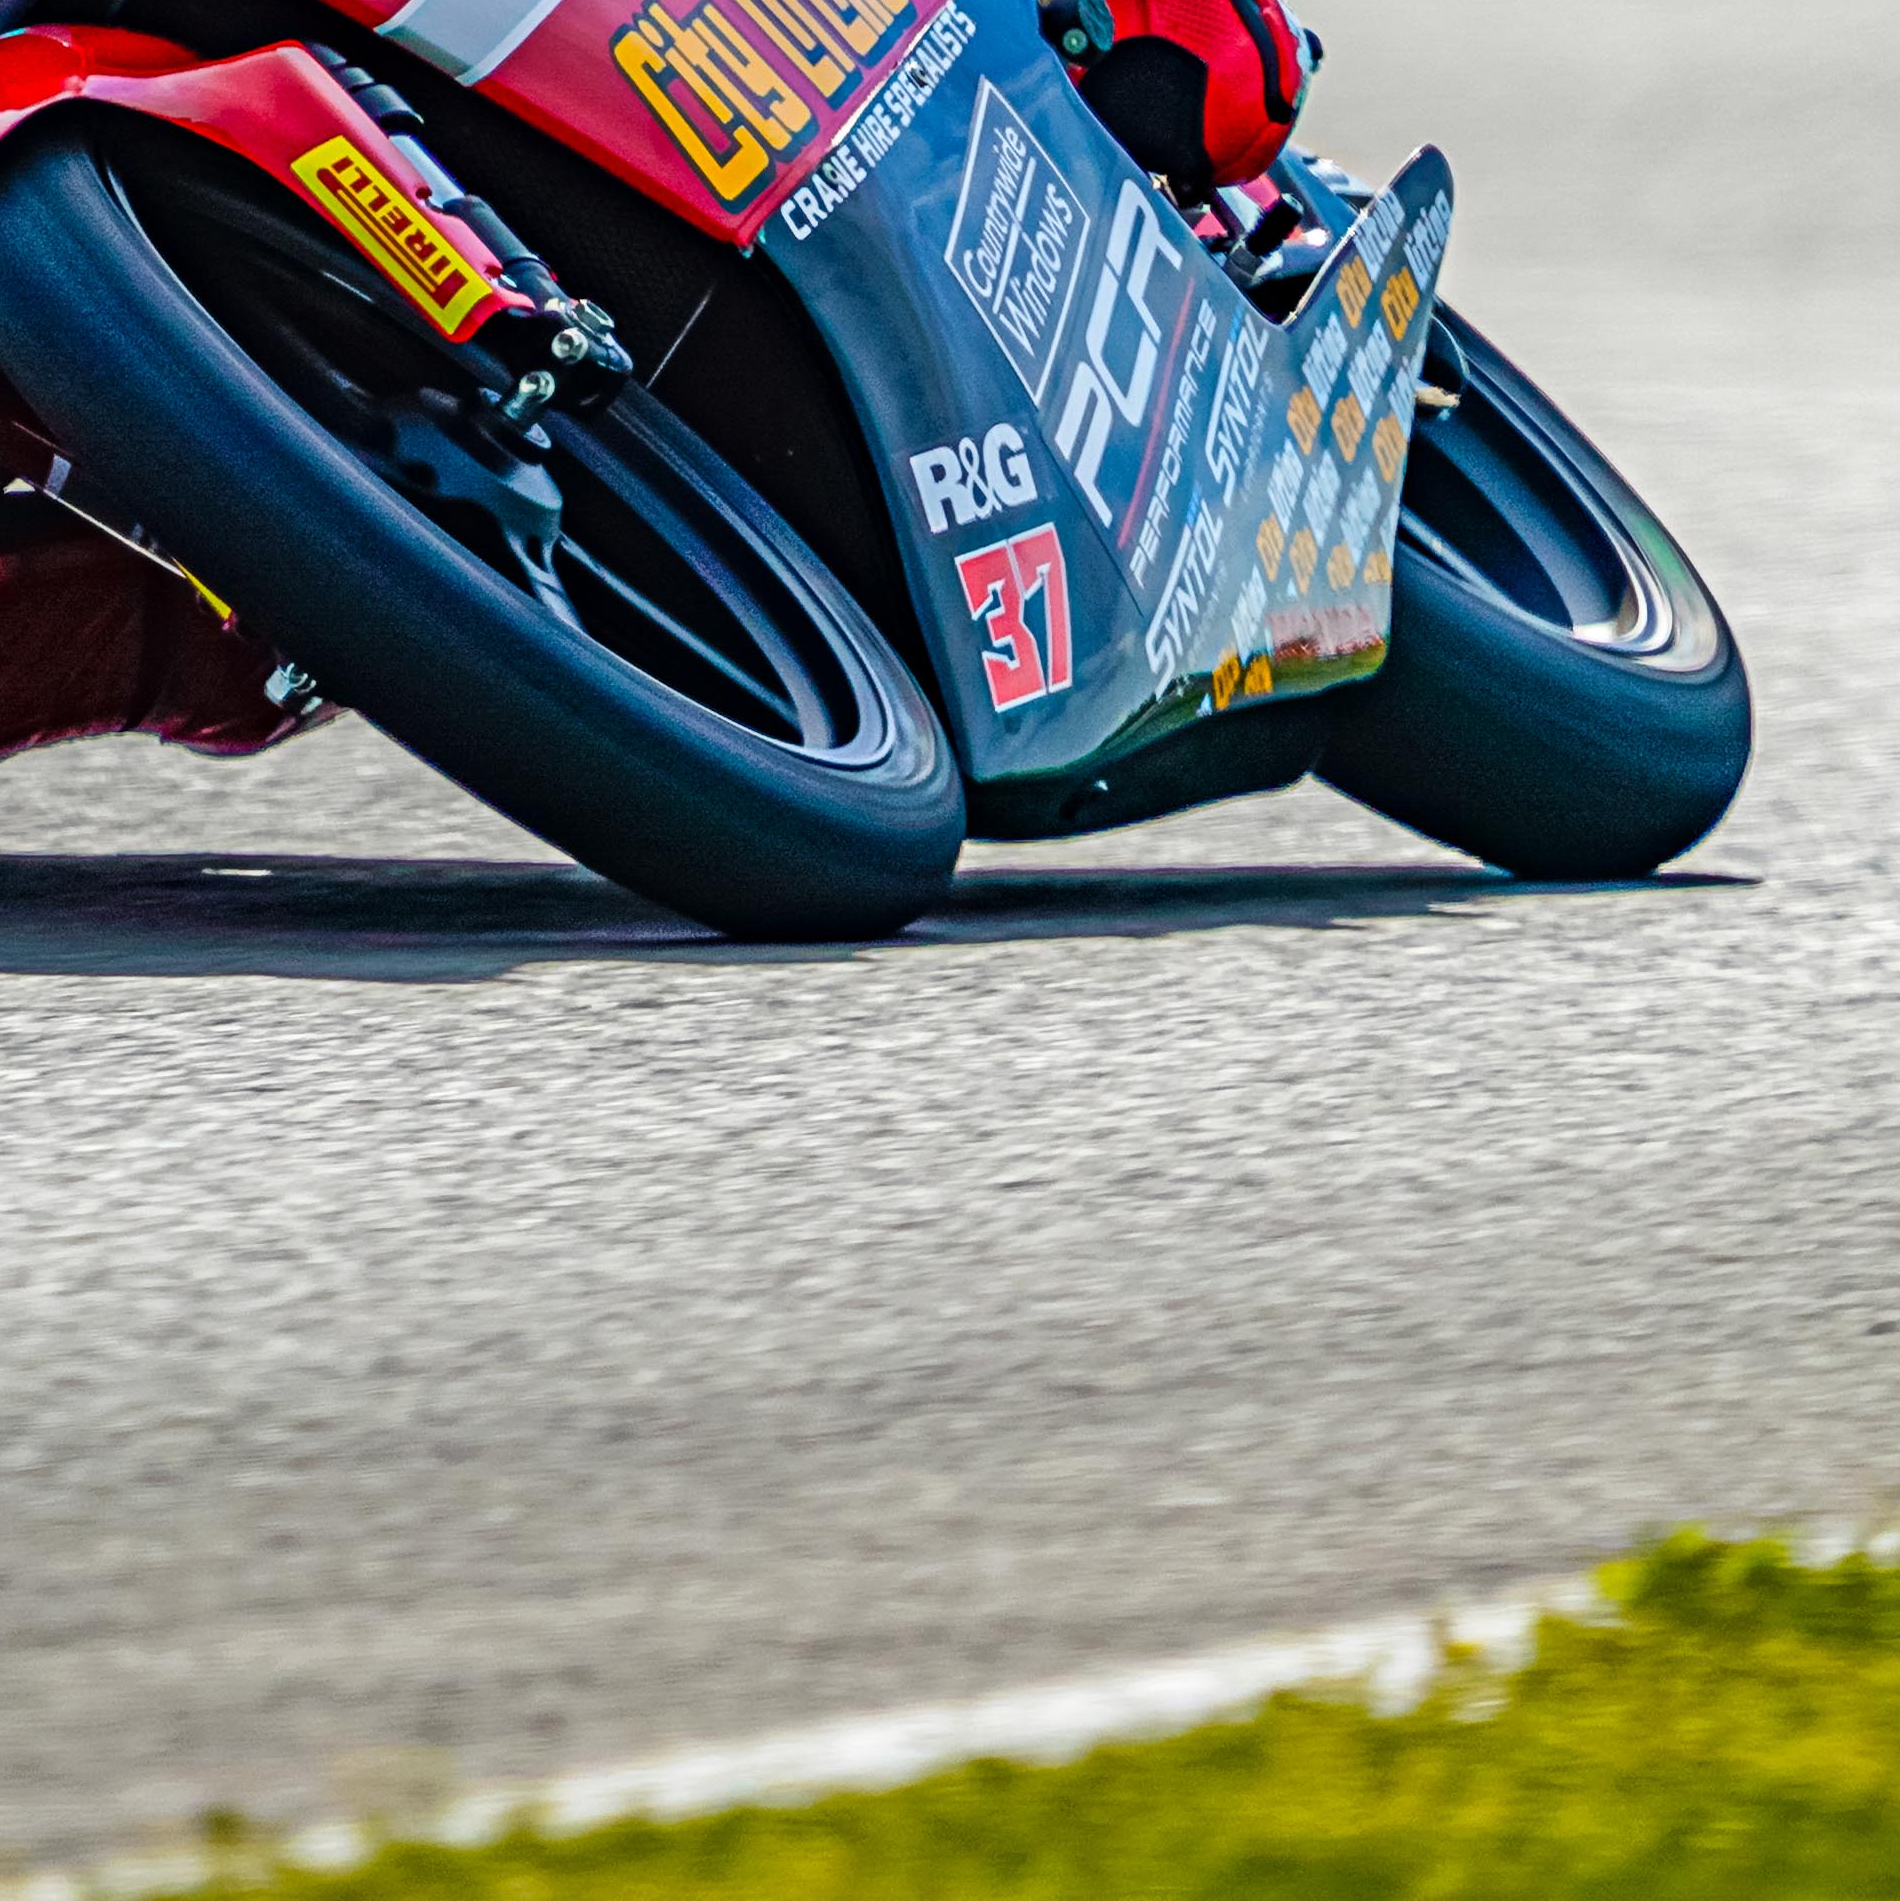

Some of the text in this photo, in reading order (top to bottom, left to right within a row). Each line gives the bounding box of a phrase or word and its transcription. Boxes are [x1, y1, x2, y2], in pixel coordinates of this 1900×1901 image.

[316, 155, 469, 310] PIRELLI
[780, 144, 867, 241] CRANE
[851, 103, 901, 168] HIRE
[963, 126, 1027, 298] Countrywide
[999, 183, 1073, 358] Windows
[1054, 178, 1183, 530] PCR
[909, 422, 1038, 535] R&G
[1129, 298, 1217, 590] PERFORMANCE
[1205, 312, 1270, 509] SYNTOL
[954, 521, 1074, 714] 37
[1145, 498, 1225, 702] SYNTOL
